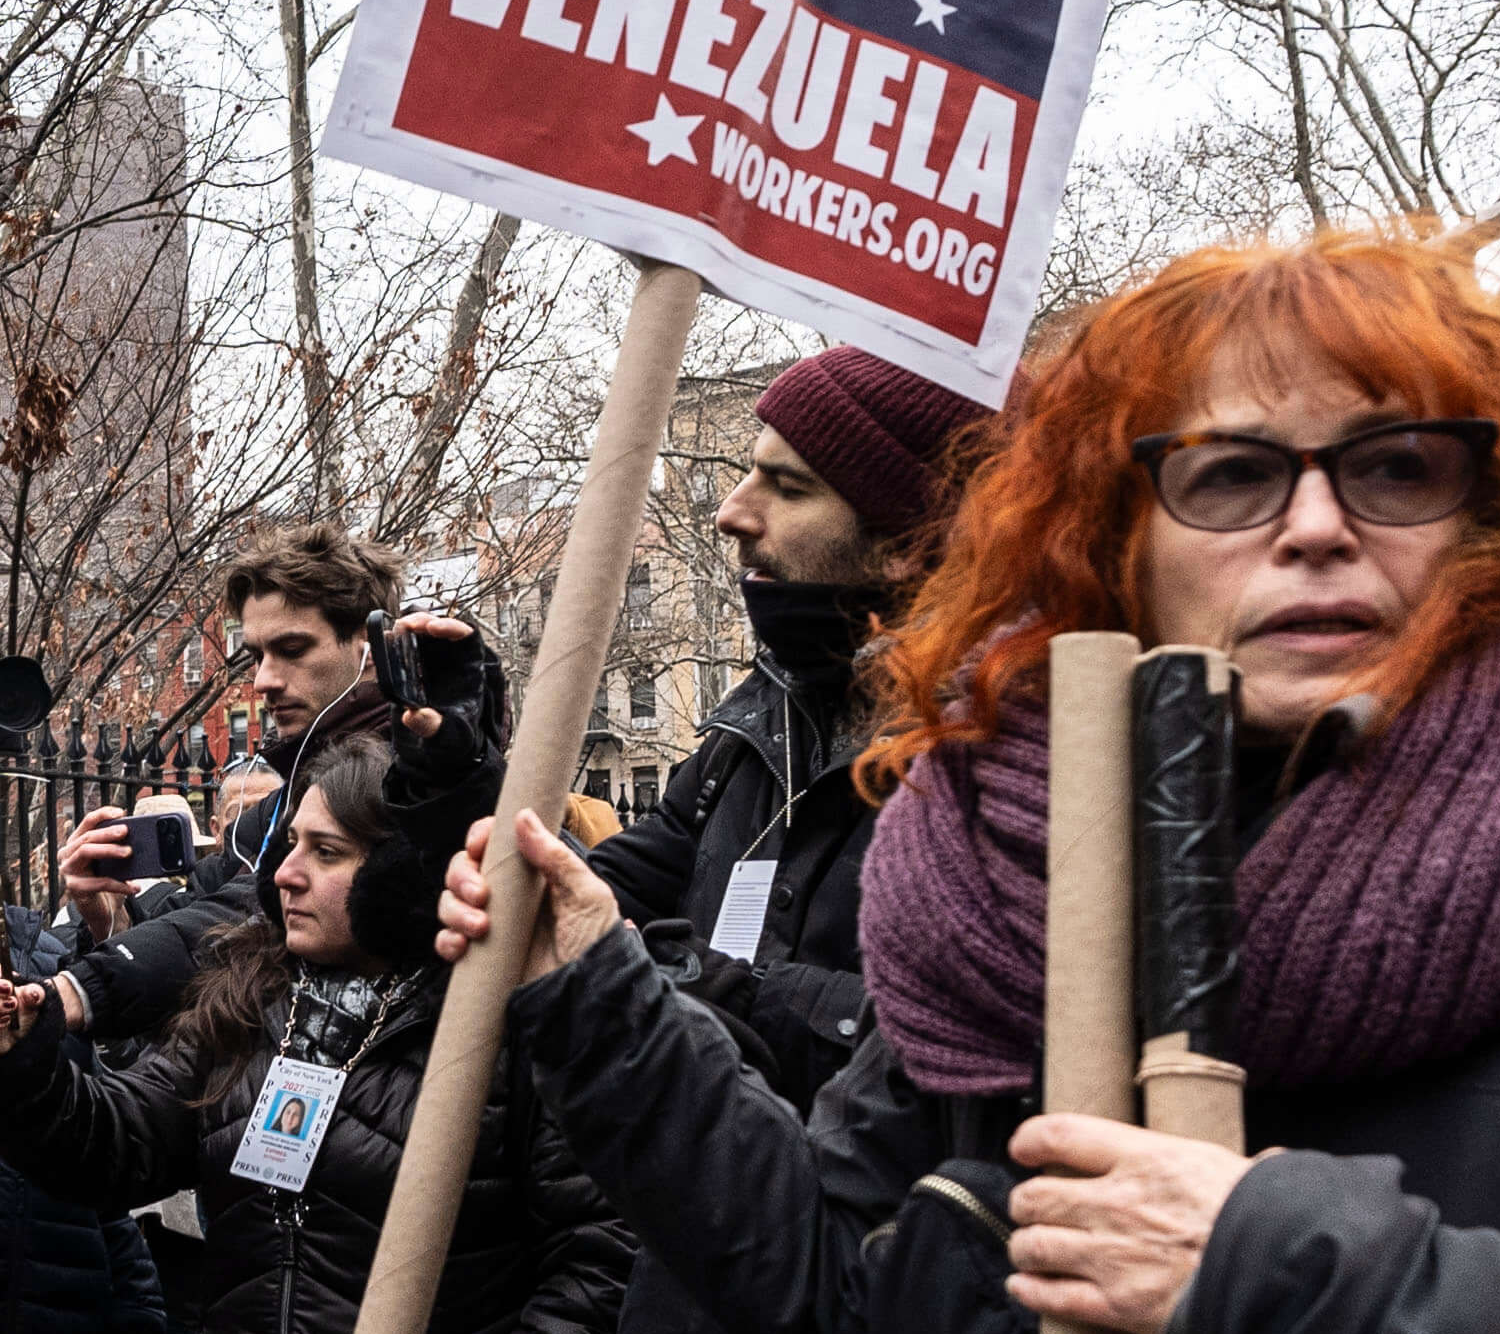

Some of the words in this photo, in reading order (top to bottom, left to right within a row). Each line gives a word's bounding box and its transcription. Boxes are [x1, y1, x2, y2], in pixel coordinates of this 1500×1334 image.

[709, 122, 996, 297] WORKERS.ORG
[280, 1066, 292, 1077] City
[302, 1072, 315, 1080] New
[316, 1075, 332, 1085] York
[243, 1079, 274, 1147] PRESS
[302, 1094, 335, 1163] PRESS
[235, 1161, 260, 1175] PRESS
[276, 1172, 304, 1185] PRESS
